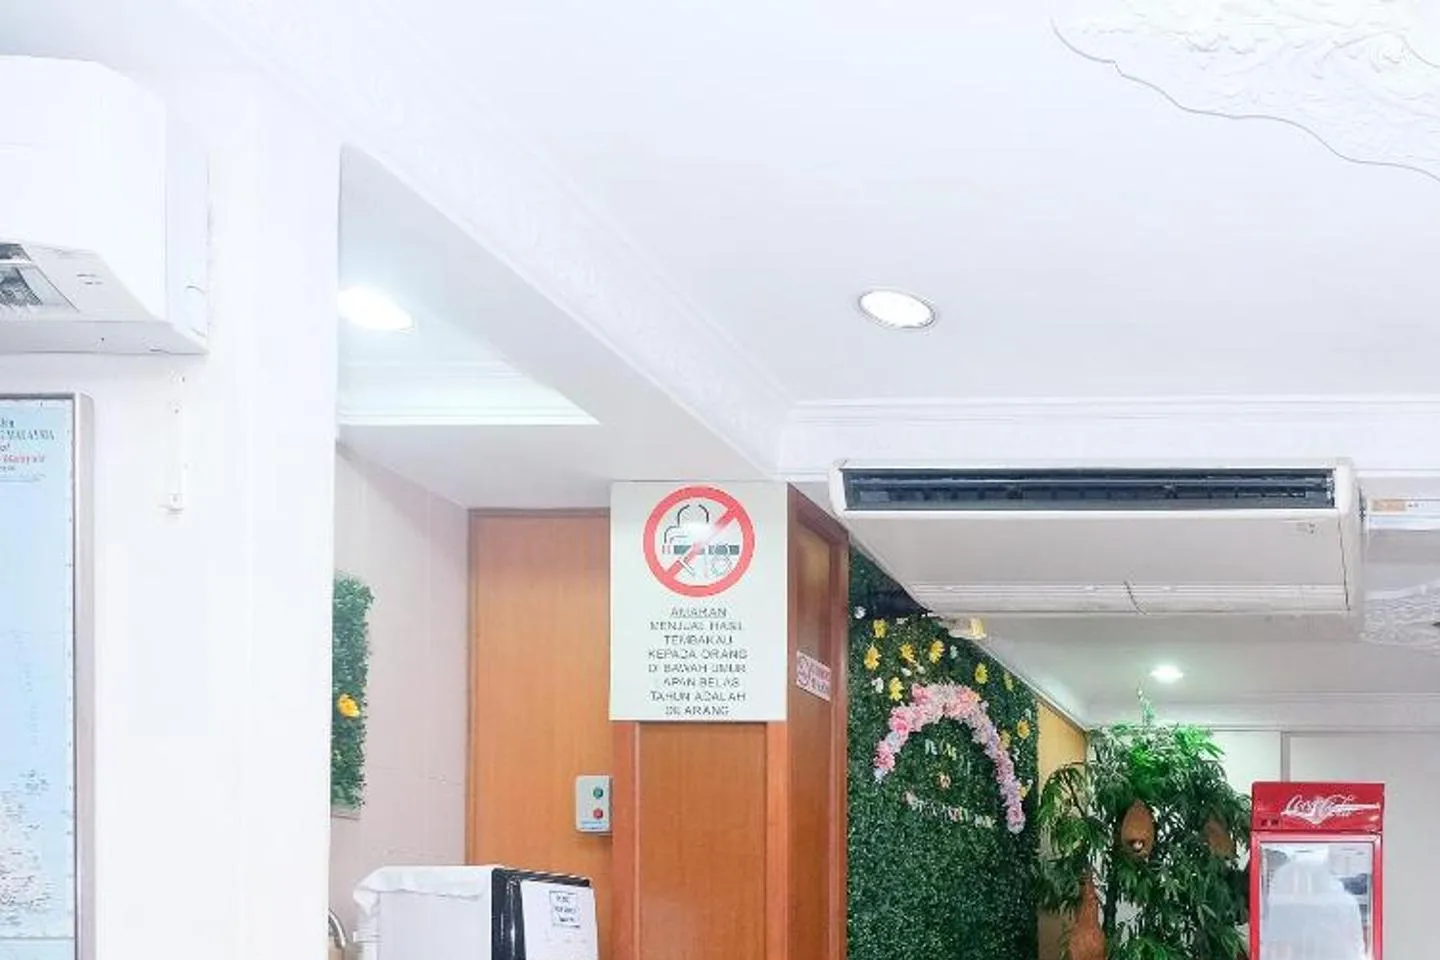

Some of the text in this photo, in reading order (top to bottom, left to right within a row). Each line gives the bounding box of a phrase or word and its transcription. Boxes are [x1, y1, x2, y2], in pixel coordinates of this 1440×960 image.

[663, 634, 734, 645] TEMBAKAU
[648, 648, 748, 660] KEPADA ORANG
[663, 663, 708, 673] BAWAH
[711, 663, 747, 673] UMUR
[699, 677, 741, 687] BELAS
[650, 691, 746, 702] TAHUN ADALAH
